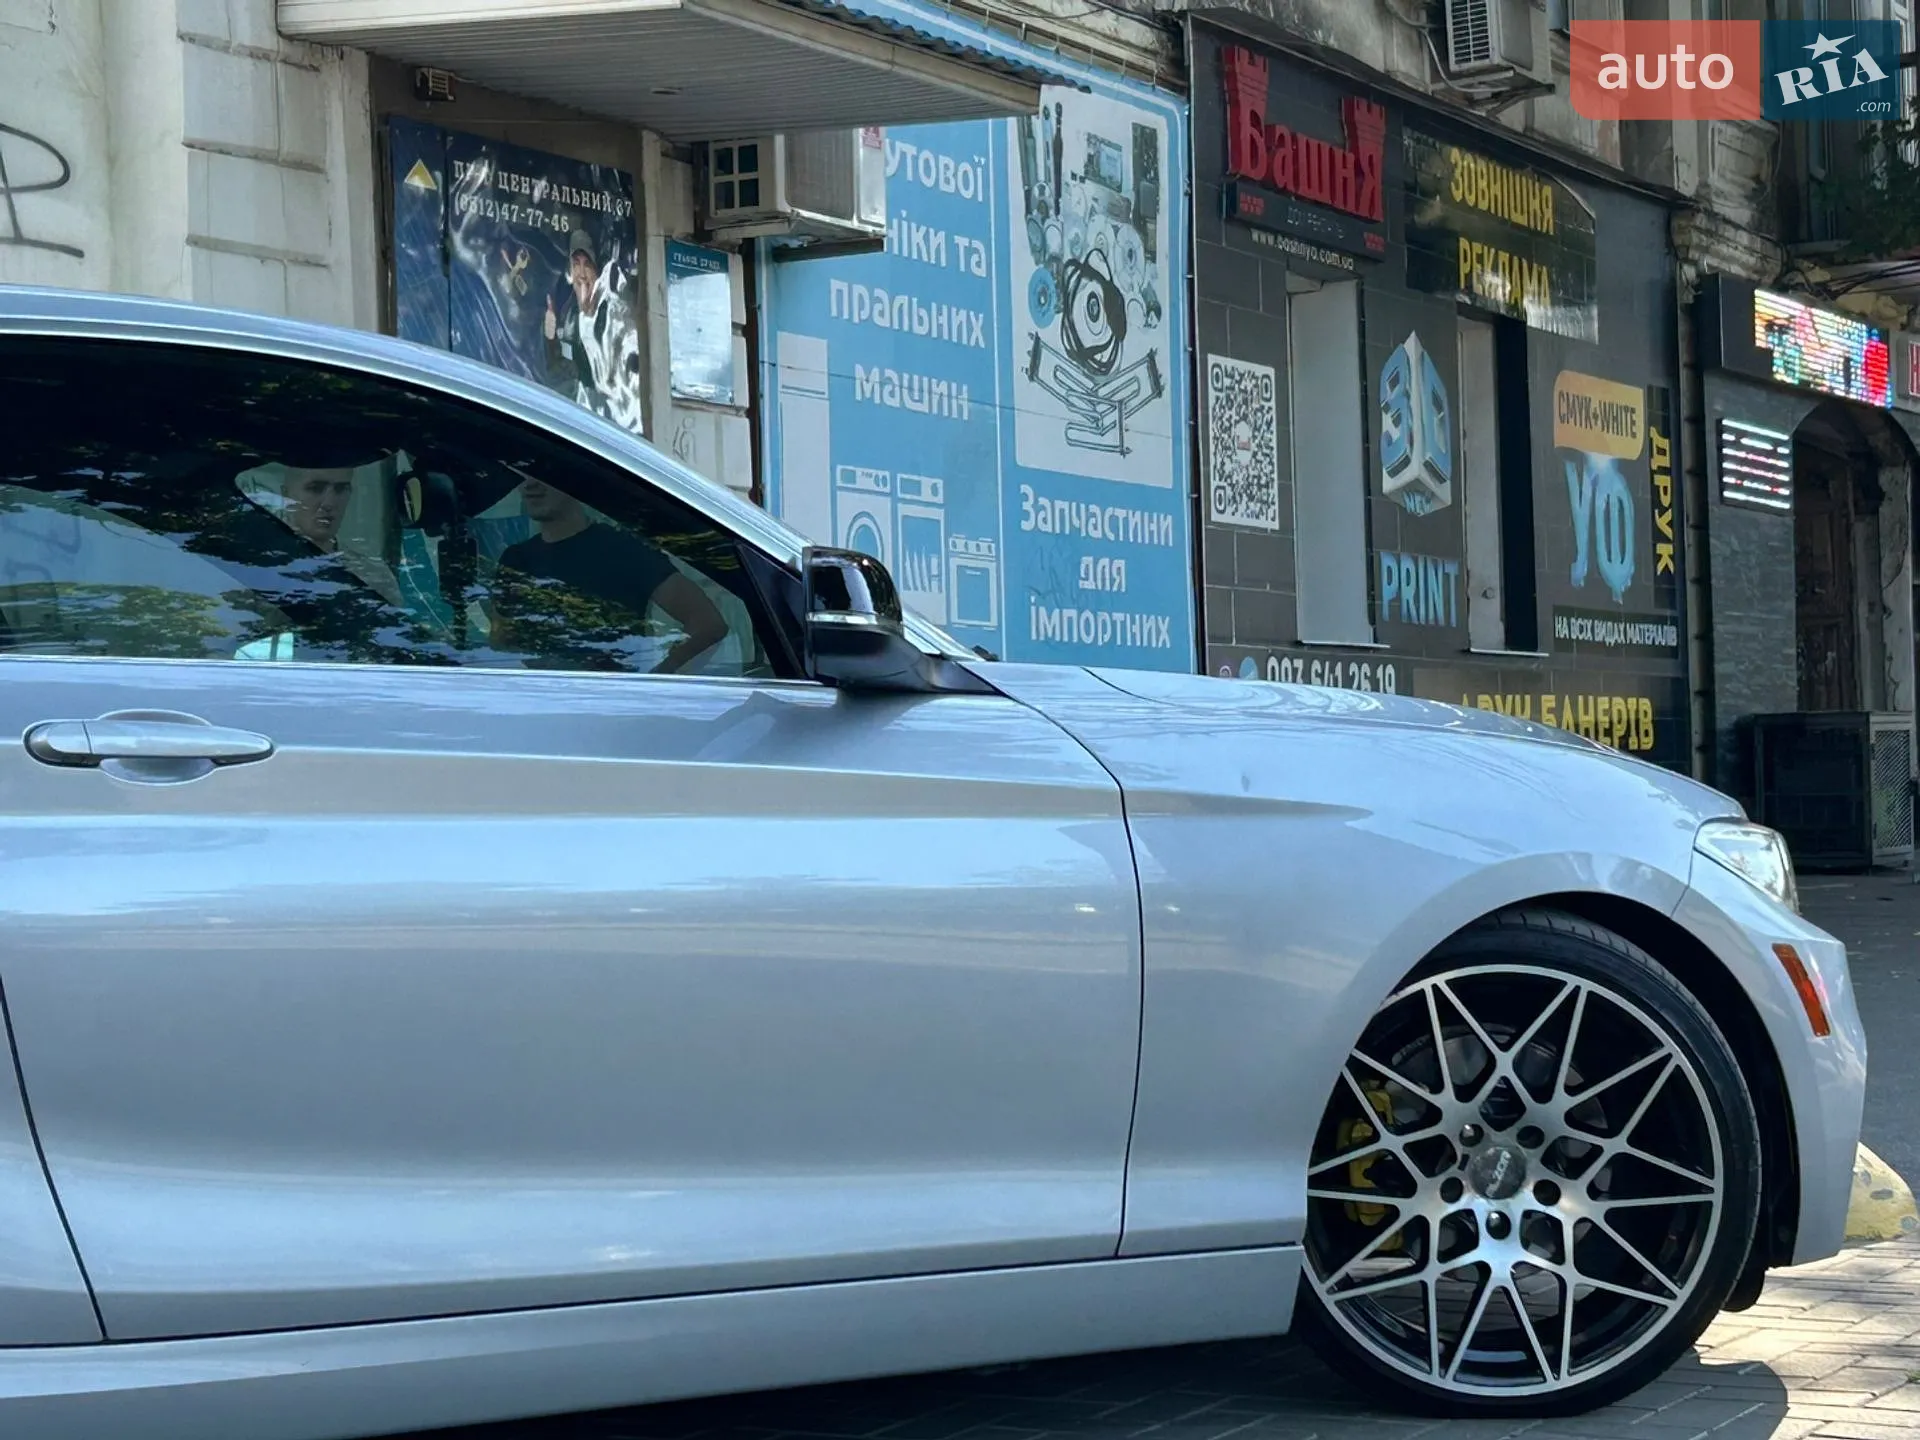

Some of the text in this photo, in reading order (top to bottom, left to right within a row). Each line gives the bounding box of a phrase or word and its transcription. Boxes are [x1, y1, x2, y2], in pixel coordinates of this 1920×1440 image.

[1450, 148, 1554, 235] ЗОВНІШНЯ
[954, 235, 987, 277] та
[1459, 236, 1551, 312] РЕКЛАМА
[830, 278, 985, 348] пральних
[854, 363, 968, 421] машин
[1019, 484, 1173, 547] Запчастини
[1649, 425, 1675, 577] ДРУК
[1079, 556, 1126, 593] для
[1380, 551, 1459, 627] PRINT
[1030, 595, 1171, 649] імпортних
[1555, 616, 1569, 639] НА
